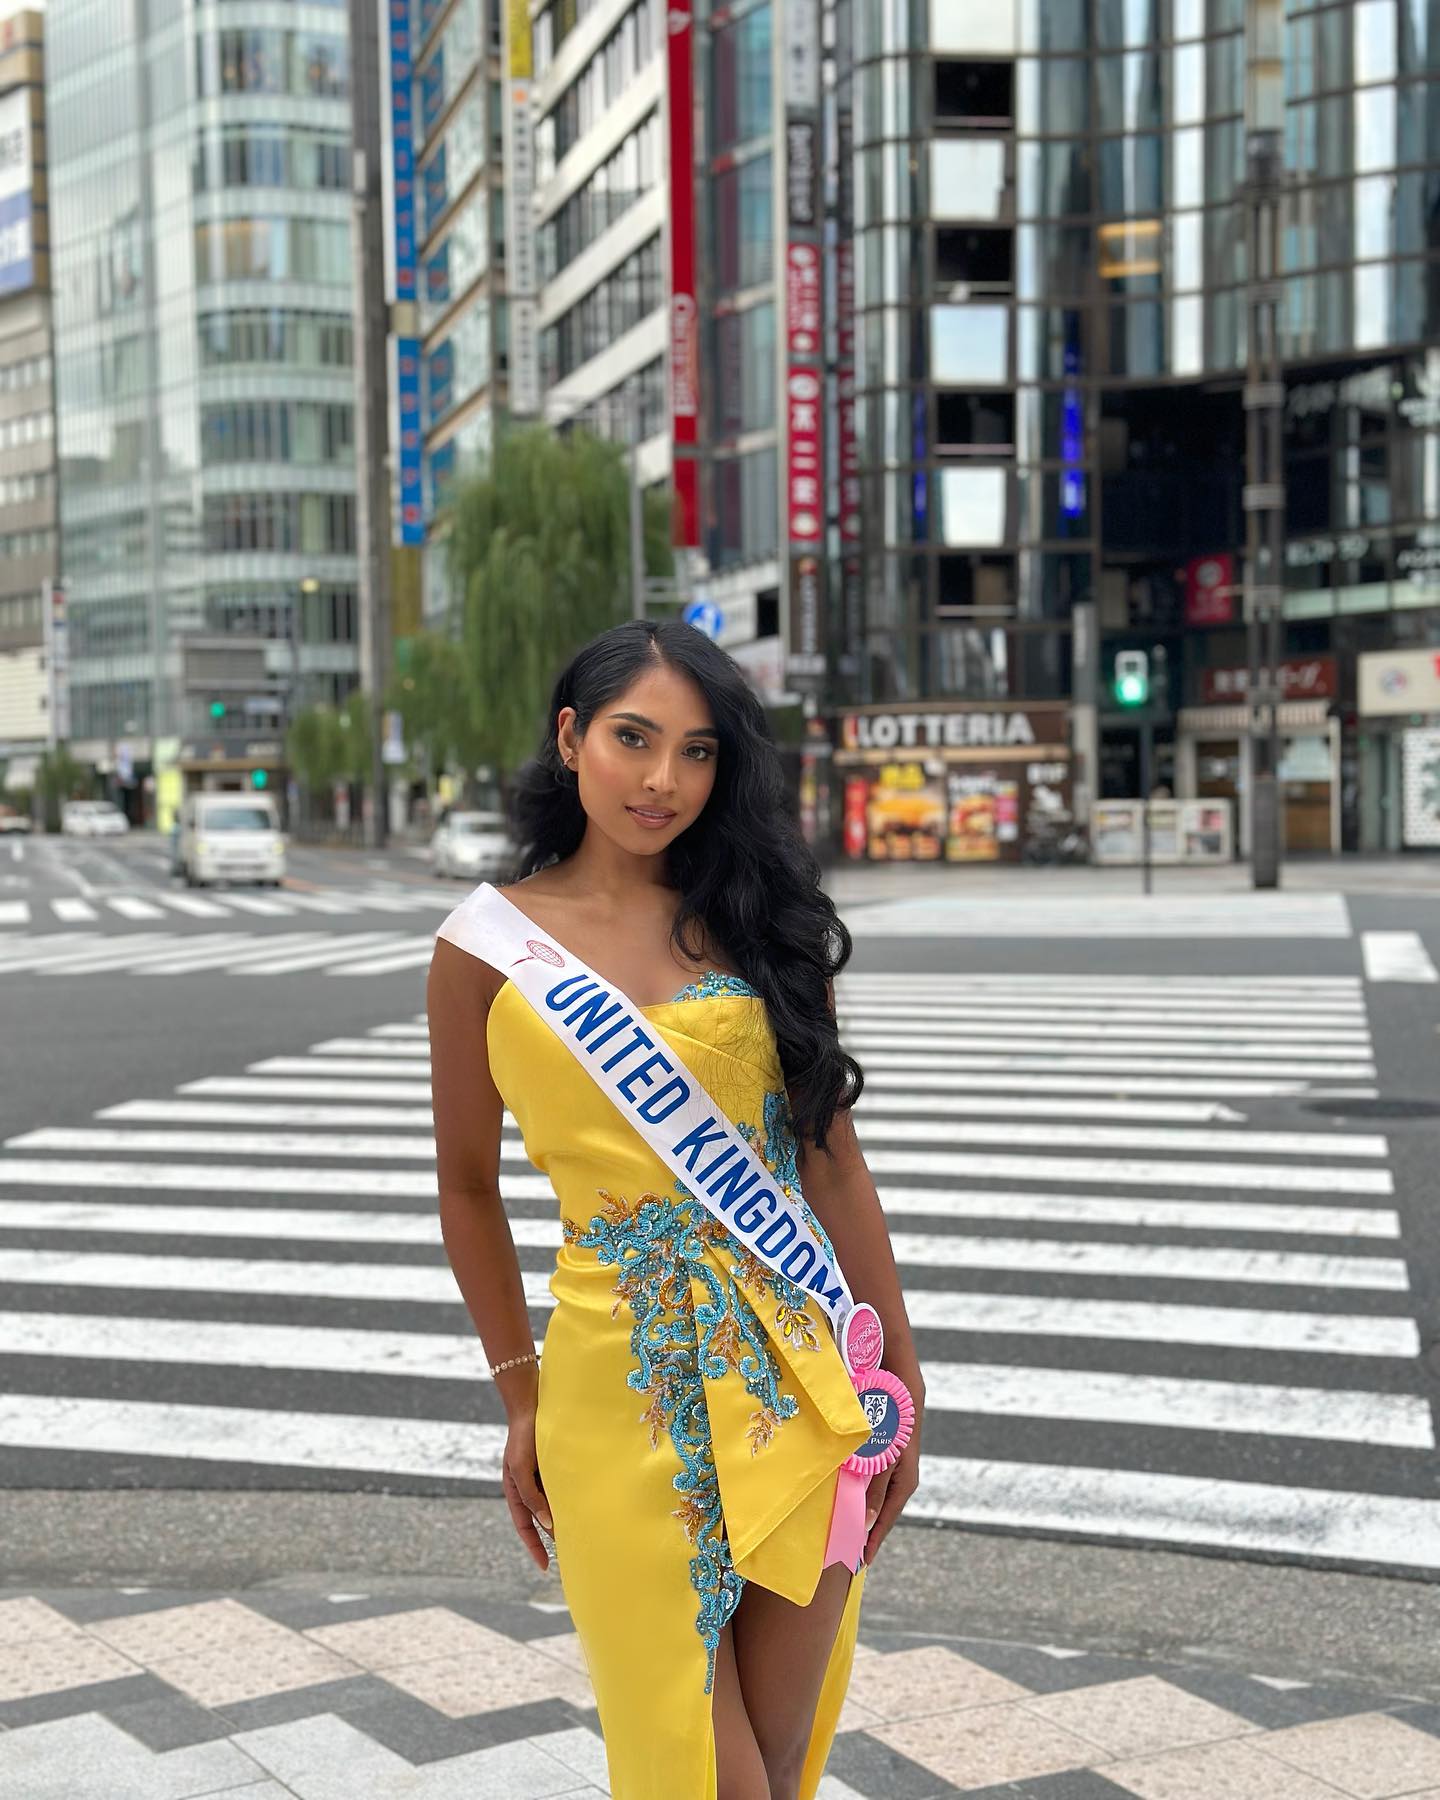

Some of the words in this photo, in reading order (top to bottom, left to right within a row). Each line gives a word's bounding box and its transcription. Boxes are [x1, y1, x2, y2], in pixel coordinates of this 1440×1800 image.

[857, 712, 1035, 747] LOTTERIA
[545, 974, 690, 1124] UNITED
[672, 1116, 844, 1309] KINGDOM
